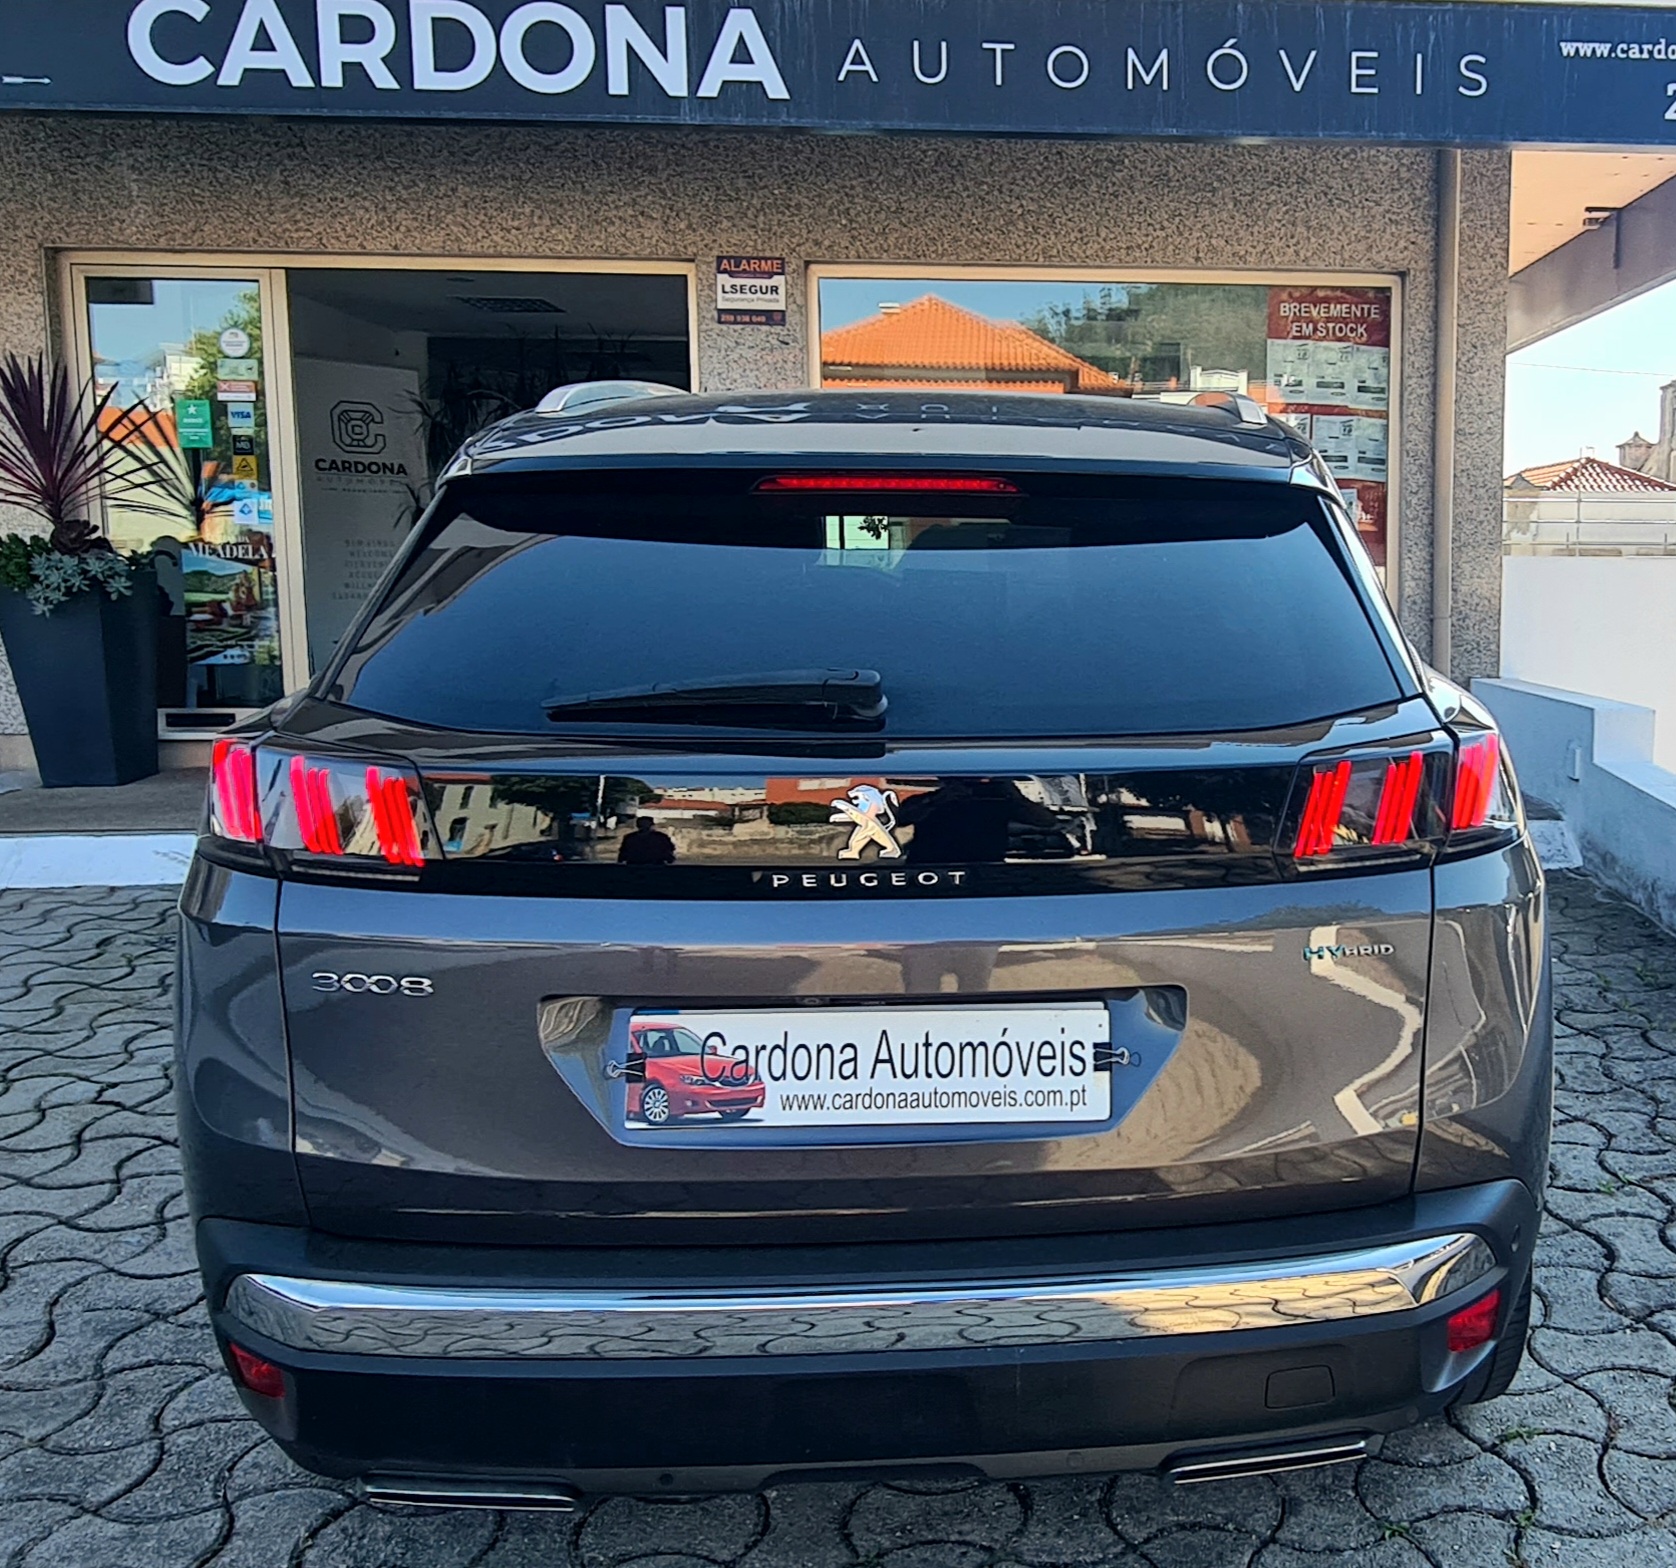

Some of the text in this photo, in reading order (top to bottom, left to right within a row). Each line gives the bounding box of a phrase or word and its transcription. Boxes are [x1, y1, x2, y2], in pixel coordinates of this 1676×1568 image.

[127, 0, 1489, 101] CARDONA AUTOMÓVEIS
[1559, 38, 1676, 60] www.cardo
[720, 259, 782, 273] ALARME
[721, 284, 779, 295] LSEGUR
[1280, 302, 1380, 318] BREVEMENTE
[1292, 322, 1367, 338] EM STOCK
[230, 411, 251, 419] VISA
[314, 458, 408, 476] CARDONA
[772, 871, 966, 888] PEUGEOT
[1303, 943, 1395, 960] HYBRID
[312, 972, 434, 997] 3008
[700, 1026, 1088, 1083] Cardona Automóveis
[779, 1083, 1088, 1112] www.cardonaautomoveis.com.pt
